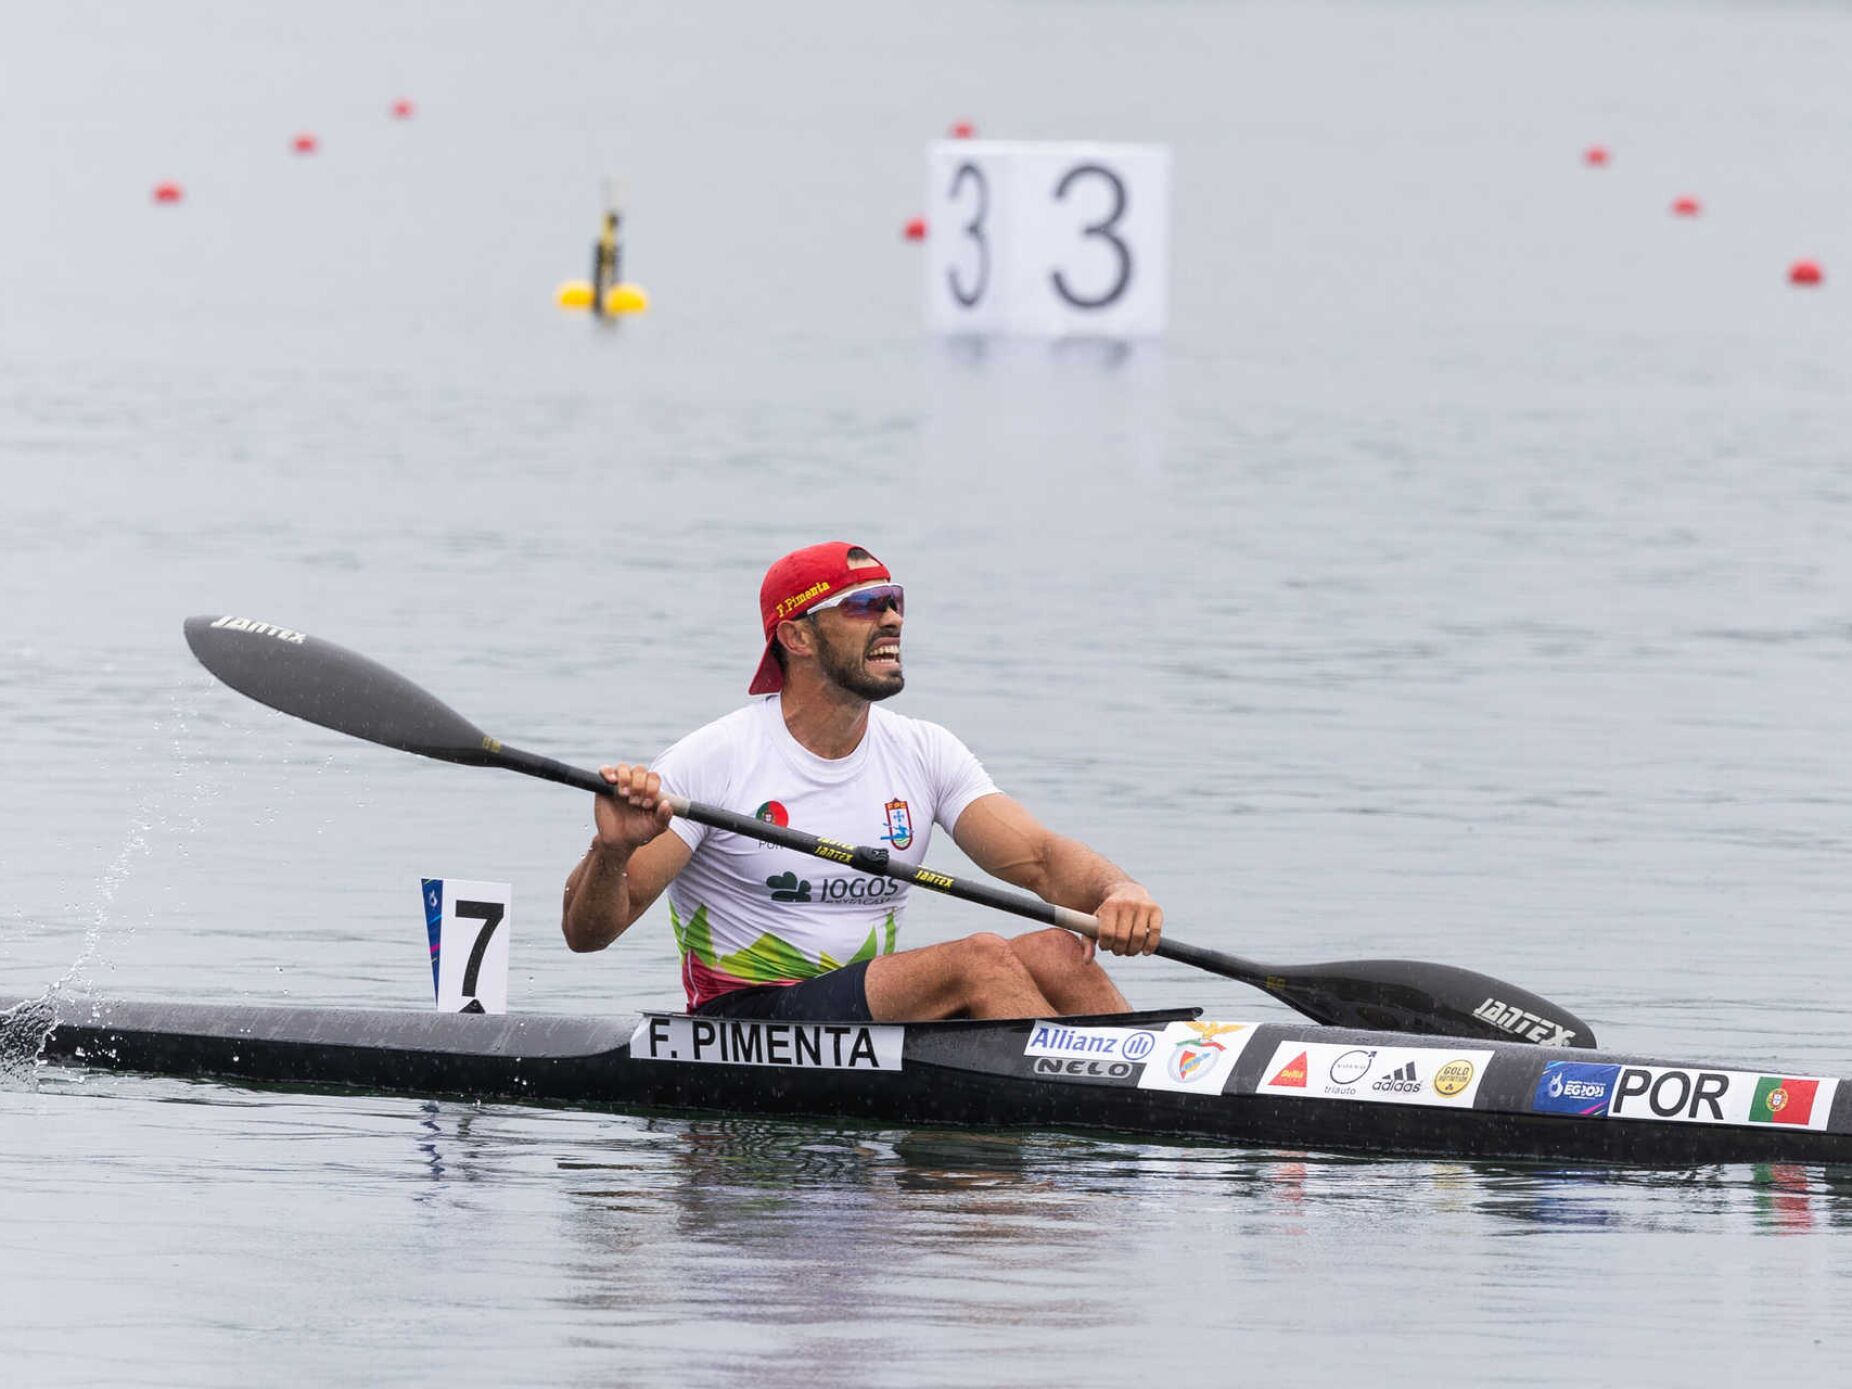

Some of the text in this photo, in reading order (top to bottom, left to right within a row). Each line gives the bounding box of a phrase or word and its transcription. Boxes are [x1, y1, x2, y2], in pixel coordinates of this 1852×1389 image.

[947, 162, 990, 308] 3
[1051, 162, 1132, 311] 3
[455, 899, 505, 998] 7
[650, 1019, 880, 1068] F. PIMENTA
[1032, 1028, 1118, 1053] Allianz
[1037, 1058, 1131, 1077] NELO
[1372, 1079, 1421, 1093] adidas
[1444, 1066, 1469, 1075] GOLD
[1324, 1086, 1357, 1096] triauto
[1613, 1069, 1729, 1120] POR
